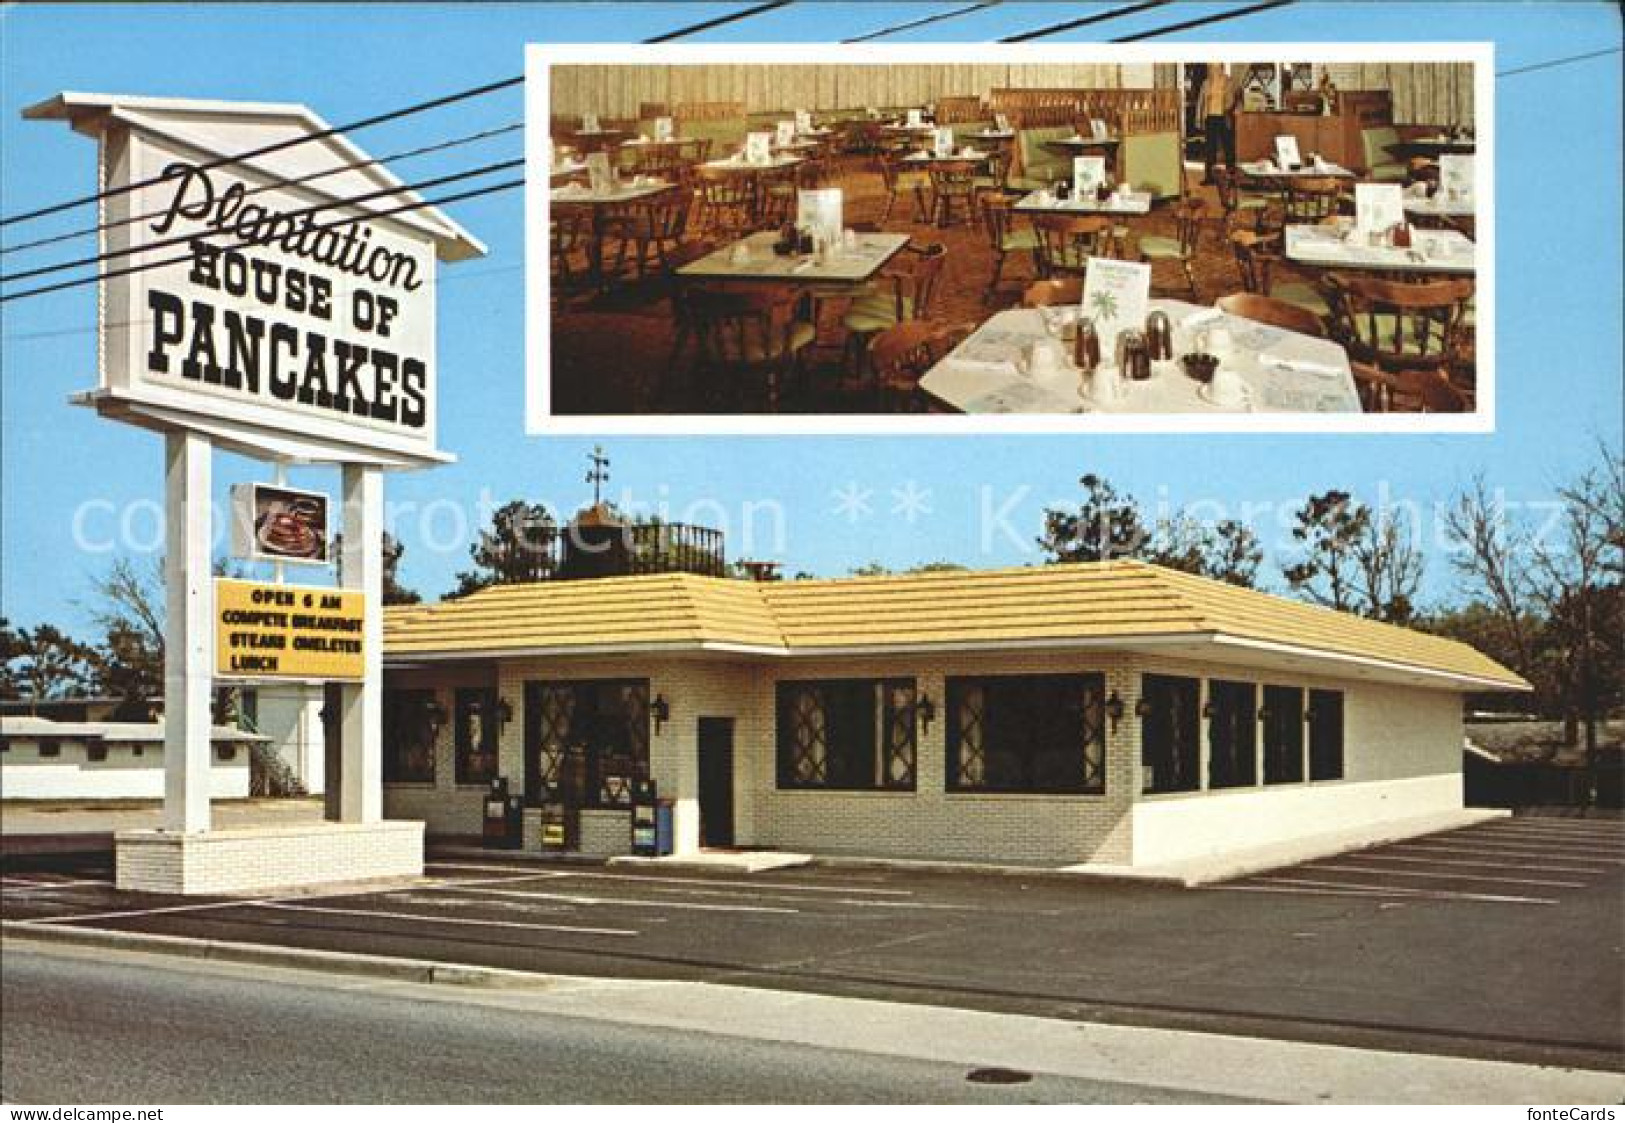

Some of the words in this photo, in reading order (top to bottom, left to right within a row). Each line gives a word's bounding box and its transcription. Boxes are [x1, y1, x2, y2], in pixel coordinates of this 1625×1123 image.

[150, 162, 422, 291] Plantation
[188, 240, 332, 320] HOUSE
[352, 289, 398, 337] OF
[148, 289, 426, 427] PANCAKES
[251, 589, 295, 606] OPEN
[320, 595, 342, 609] AM
[230, 655, 279, 672] LUNCH
